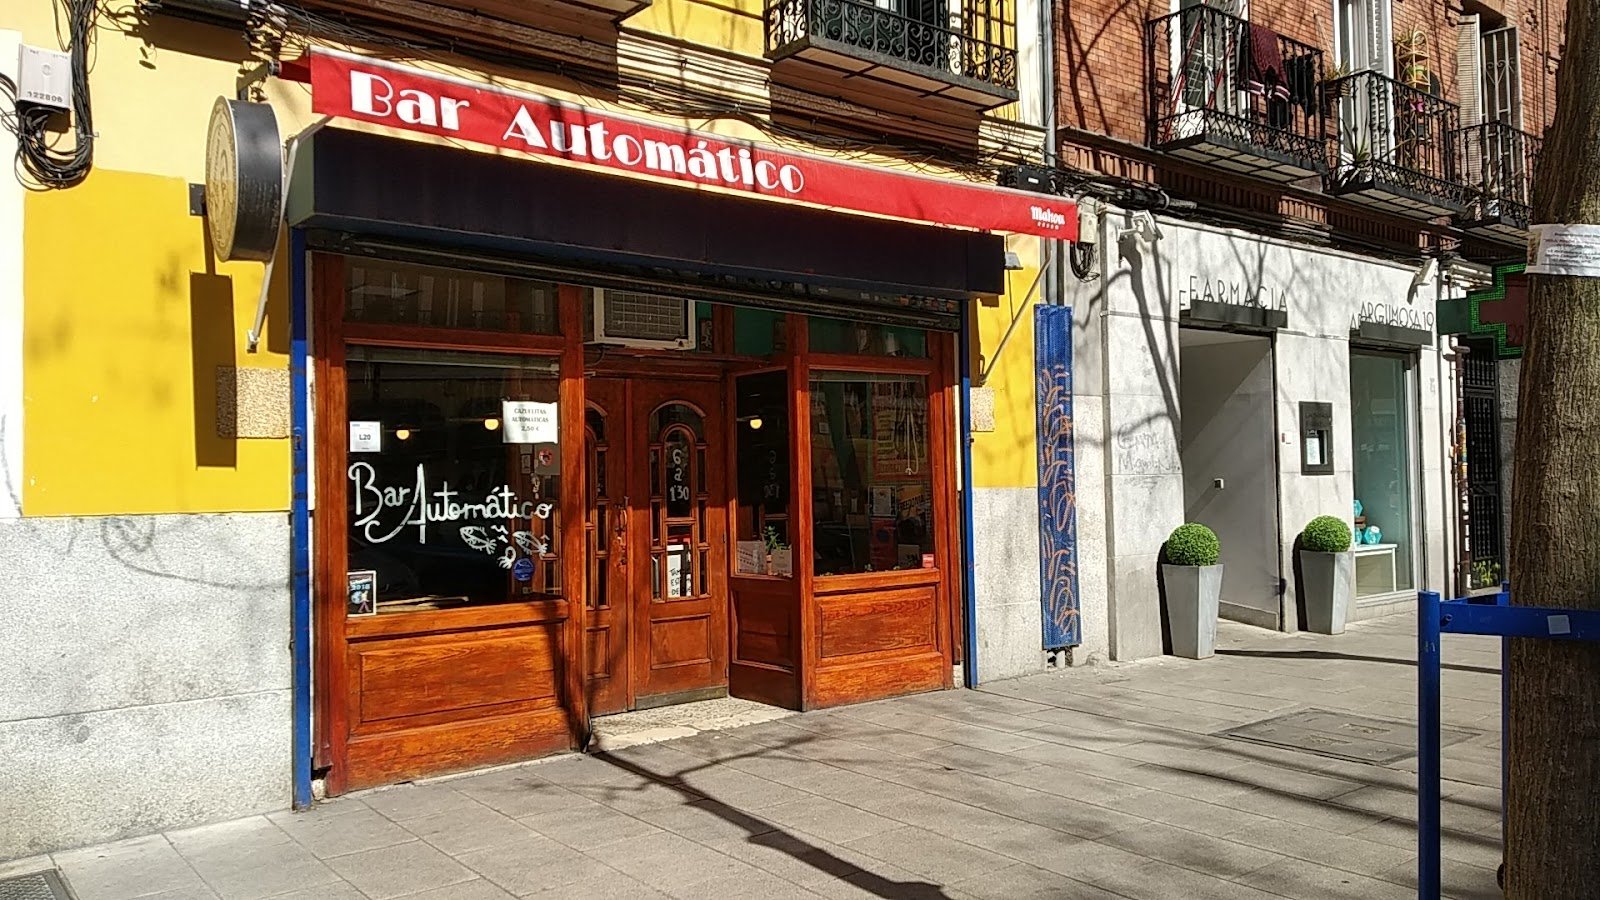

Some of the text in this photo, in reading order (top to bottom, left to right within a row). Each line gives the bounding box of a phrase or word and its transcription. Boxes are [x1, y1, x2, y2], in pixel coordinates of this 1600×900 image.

[350, 70, 804, 193] Bar Automático
[1031, 205, 1065, 225] Mahou
[1189, 275, 1287, 312] FARMACIA
[1361, 301, 1435, 332] ARGUMOSA 19
[672, 448, 682, 465] 6
[348, 461, 553, 545] Bar Automático
